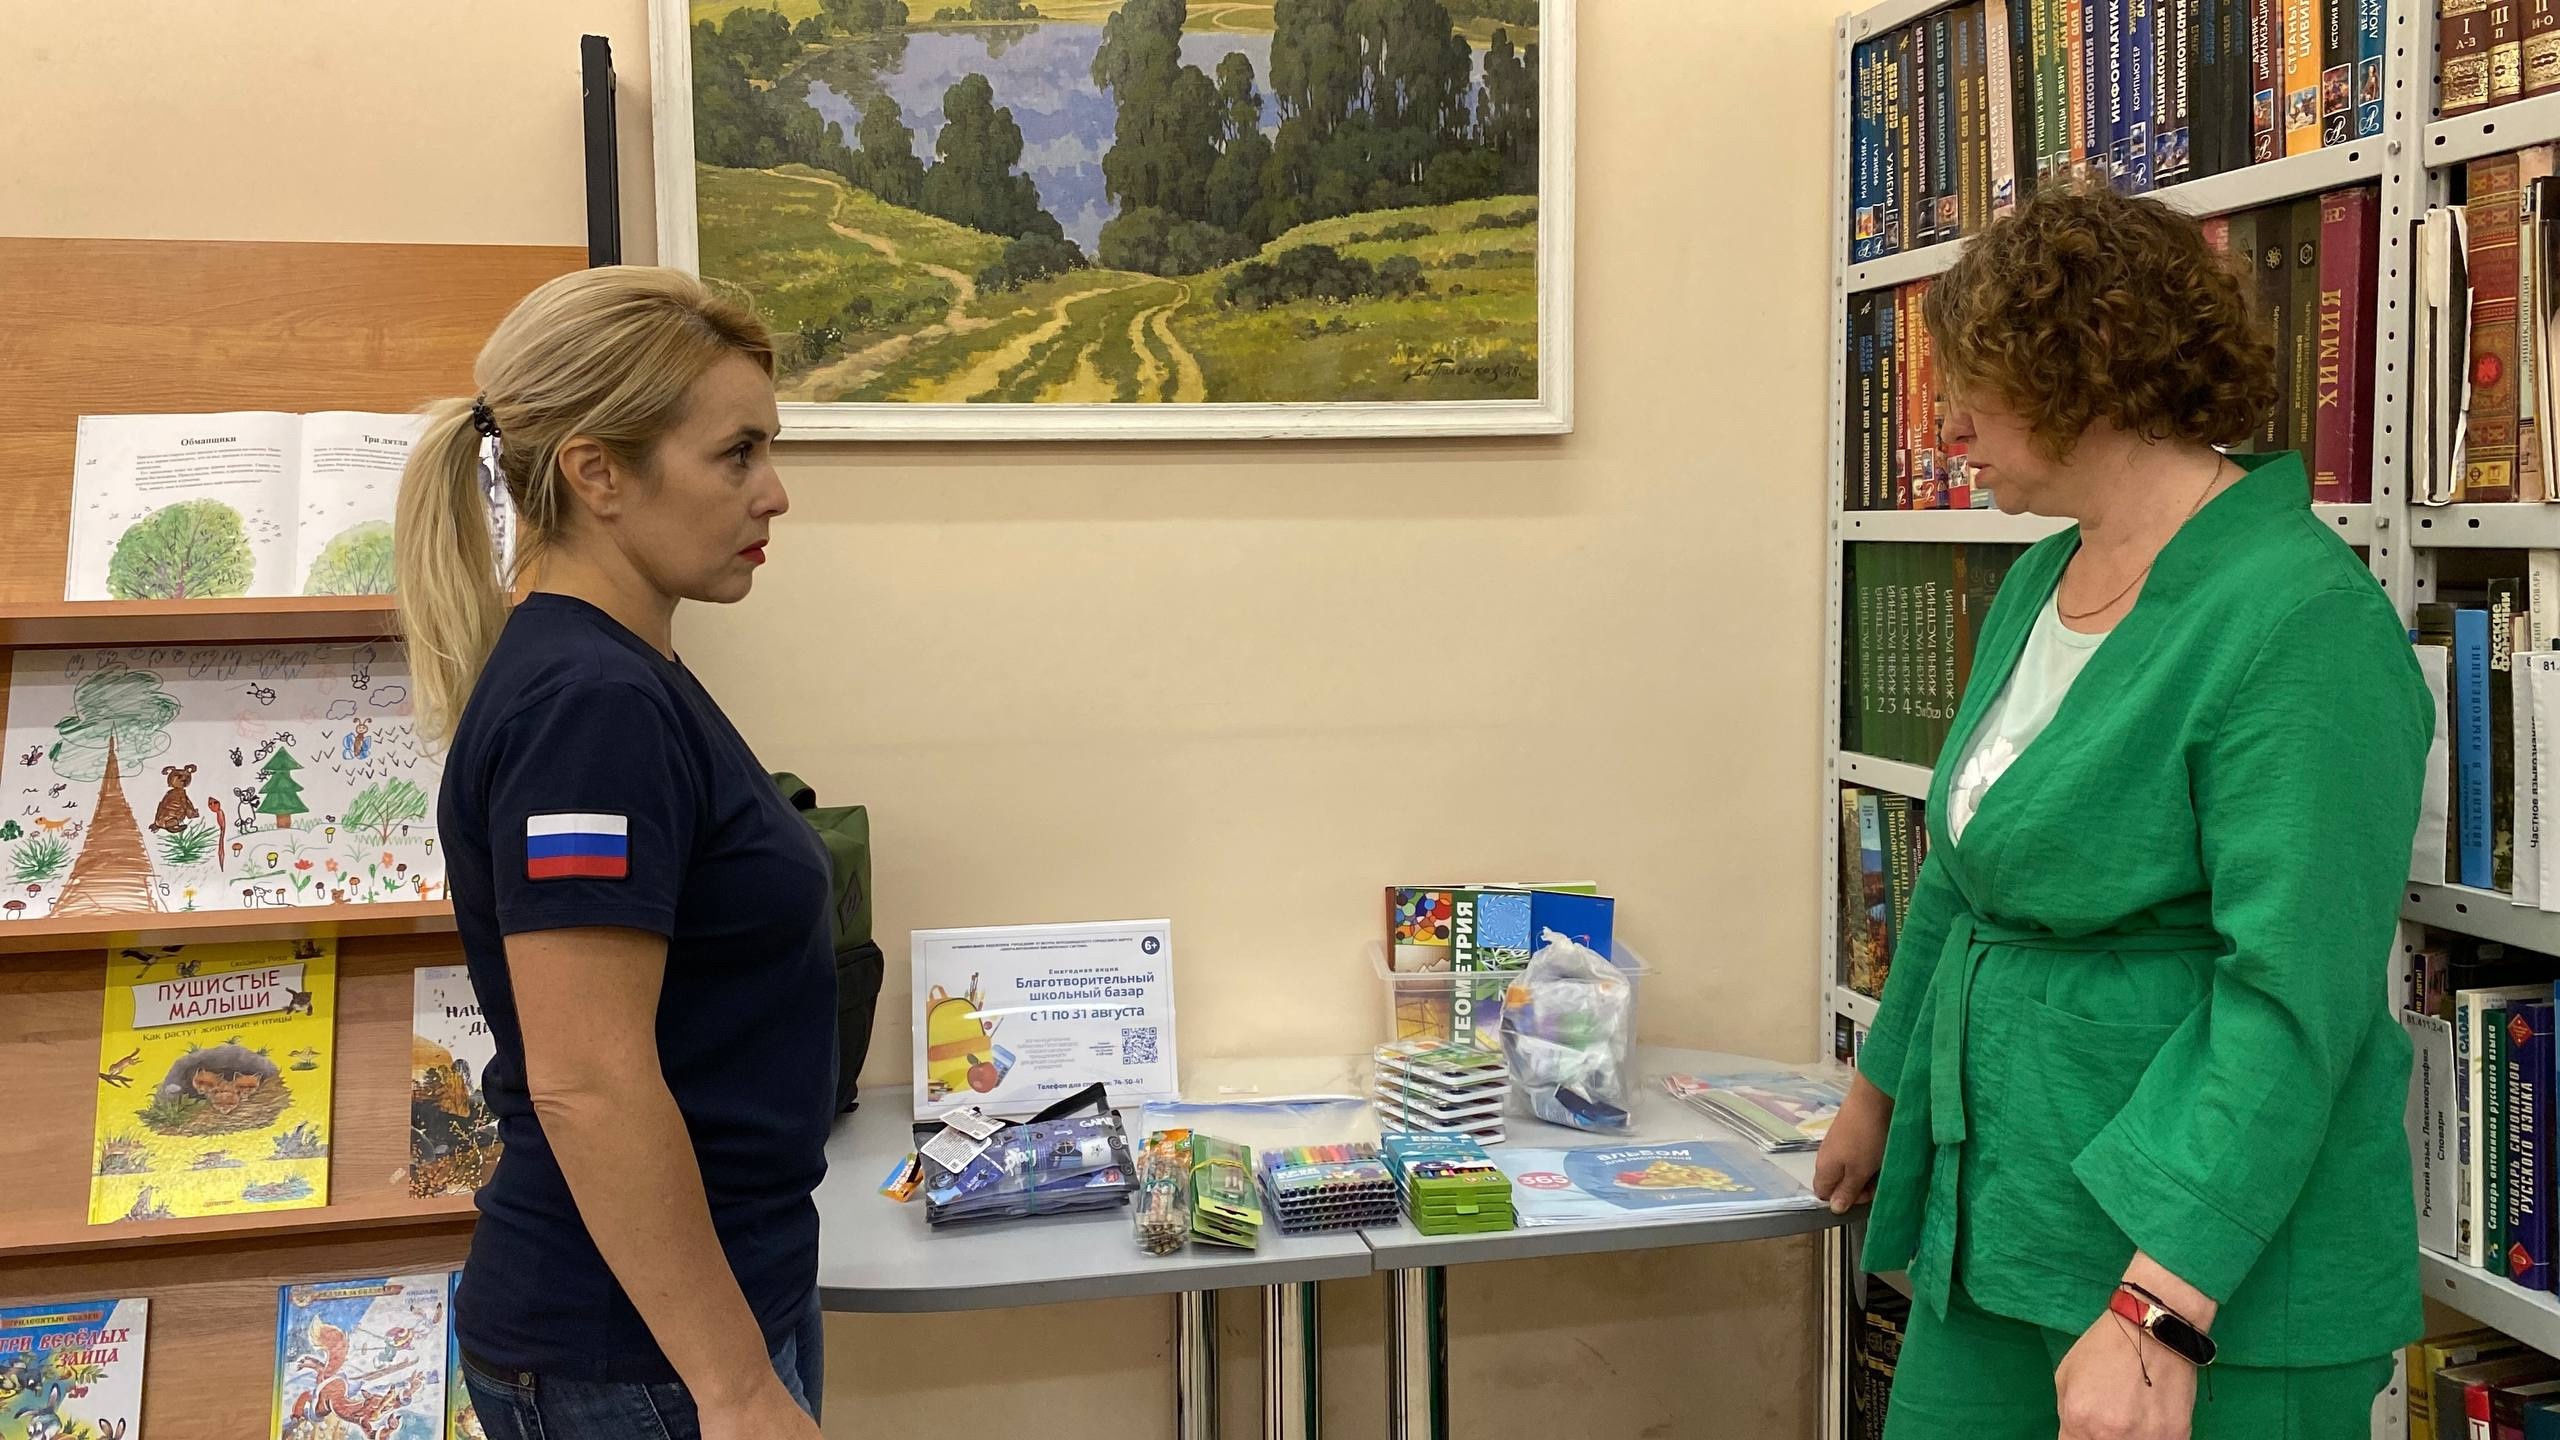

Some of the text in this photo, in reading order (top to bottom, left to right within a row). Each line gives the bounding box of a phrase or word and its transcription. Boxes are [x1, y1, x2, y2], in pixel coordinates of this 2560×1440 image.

[2252, 15, 2260, 64] ДРЕВНИЕ
[2288, 5, 2298, 74] СТРАНЫ
[2331, 7, 2339, 49] ИСТОРИЯ
[2057, 65, 2065, 94] ЗВЕРИ
[2071, 9, 2082, 149] ЭНЦИКЛОПЕДИЯ ДЛЯ
[2085, 5, 2096, 148] ЭНЦИКЛОПЕДИЯ ДЛЯ
[2133, 46, 2141, 111] КОМПЬЮТЕР
[2157, 7, 2166, 125] ЭНЦИКЛОПЕДИЯ
[2177, 0, 2187, 119] ЭНЦИКЛОПЕДИЯ
[1888, 62, 1898, 129] ДЛЯ ДЕТЕЙ
[1916, 27, 1926, 193] ЭНЦИКЛОПЕДИЯ ДЛЯ ДЕТЕЙ
[1935, 21, 1946, 190] ЭНЦИКЛОПЕДИЯ ДЛЯ ДЕТЕЙ
[1960, 79, 1968, 111] ДЕТЕЙ
[1977, 76, 1986, 109] ДЕТЕЙ
[2036, 73, 2044, 100] ЗВЕРИ
[2037, 104, 2044, 112] И
[1901, 115, 1909, 145] ДЕТЕЙ
[1961, 115, 1969, 137] ДЛЯ
[1979, 114, 1987, 135] ДЛЯ
[1991, 105, 2000, 171] РОССИЯ
[1886, 152, 1894, 207] ФИЗИКА
[1902, 171, 1910, 250] ЭНЦИКЛОПЕДИЯ
[1907, 296, 1917, 395] ЭНЦИКЛОПЕДИЯ
[2319, 288, 2342, 409] ХИМИЯ
[180, 435, 237, 447] Обманщики
[362, 434, 380, 445] Три
[1861, 378, 1870, 507] ЭНЦИКЛОПЕДИЯ ДЛЯ ДЕТЕЙ
[1880, 357, 1889, 499] ЭНЦИКЛОПЕДИЯ ДЛЯ ДЕТЕЙ
[1914, 423, 1923, 470] БИЗНЕС
[2532, 570, 2541, 614] СЛОВАРЬ
[1886, 584, 1897, 696] ЖИЗНЬ РАСТЕНИЙ
[1899, 586, 1911, 695] ЖИЗНЬ РАСТЕНИЙ
[1913, 585, 1925, 696] ЖИЗНЬ РАСТЕНИЙ
[1924, 581, 1937, 697] ЖИЗНЬ РАСТЕНИЙ
[1943, 589, 1954, 700] ЖИЗНЬ РАСТЕНИЙ
[2491, 603, 2502, 670] Русские
[2500, 592, 2511, 672] фамилии
[1863, 695, 1870, 711] 1
[1877, 697, 1885, 713] 2
[1887, 697, 1897, 714] 3
[1903, 697, 1912, 715] 4
[1945, 703, 1955, 719] 6
[2471, 644, 2482, 848] ВВЕДЕНИЕ В ЯЗЫКОВЕДЕНИЕ
[1888, 811, 1900, 875] СПРАВОЧНИК
[2530, 797, 2539, 849] Частное
[1897, 810, 1909, 890] ПРЕПАРАТОВ
[1048, 966, 1119, 975] Ежегодная акция
[1145, 940, 1158, 951] 6+
[158, 969, 281, 1002] ПУШИСТЫЕ
[1015, 972, 1155, 989] Благотворительный
[1029, 986, 1144, 1001] школьный базар
[1454, 901, 1474, 1045] ГЕОМЕТРИЯ
[142, 1031, 161, 1042] Как
[164, 1028, 198, 1041] растут
[200, 1022, 251, 1034] животные
[261, 1015, 293, 1027] птицы
[168, 991, 271, 1021] МАЛЫШИ
[1030, 1012, 1037, 1021] с
[1041, 1010, 1047, 1020] 1
[1052, 1010, 1069, 1020] по
[1091, 1007, 1145, 1020] августа
[1037, 1083, 1068, 1091] Телефон
[2437, 1110, 2445, 1161] Словари
[2487, 1025, 2499, 1230] Словарь антонимов русского языка
[2509, 1061, 2520, 1226] СЛОВАРЬ СИНОНИМОВ
[2520, 1082, 2533, 1214] РУССКОГО ЯЗЫКА
[1518, 1175, 1570, 1185] 365
[2422, 1171, 2433, 1218] Русский
[40, 1327, 130, 1350] ВЕСЁЛЫХ
[56, 1347, 119, 1367] ЗАЙЦА
